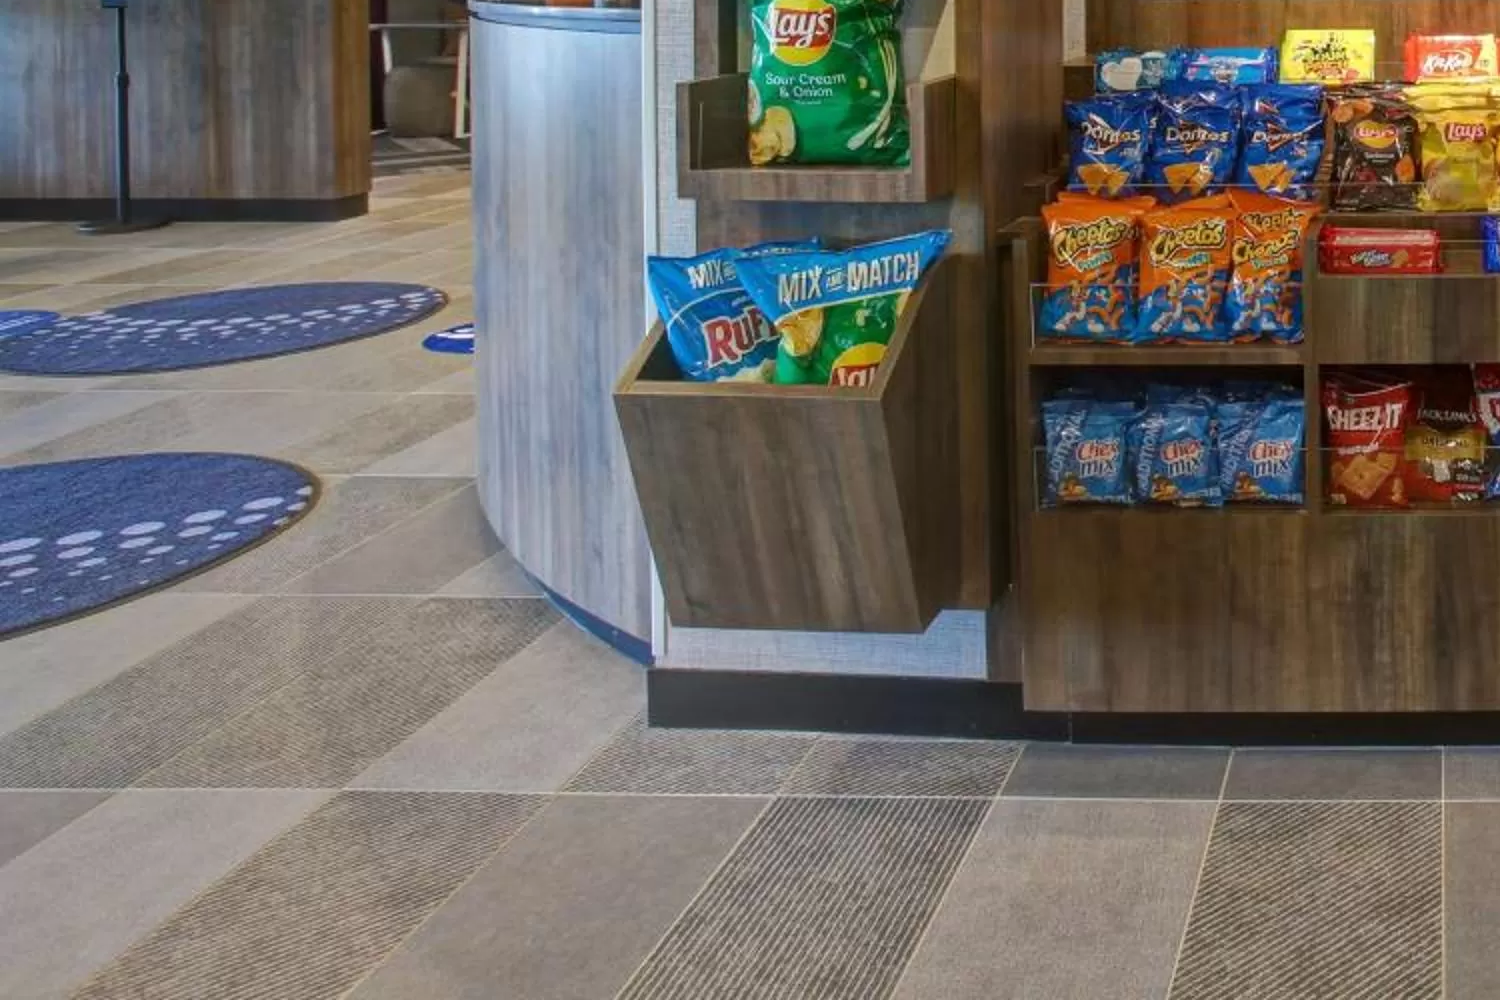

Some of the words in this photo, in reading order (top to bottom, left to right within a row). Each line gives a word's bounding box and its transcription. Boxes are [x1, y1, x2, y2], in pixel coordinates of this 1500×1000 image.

[765, 72, 794, 85] Sour
[799, 71, 846, 85] Cream
[780, 86, 790, 97] &
[793, 86, 833, 97] Onion
[687, 260, 723, 289] MIX
[778, 265, 823, 304] MIX
[847, 250, 921, 291] MATCH
